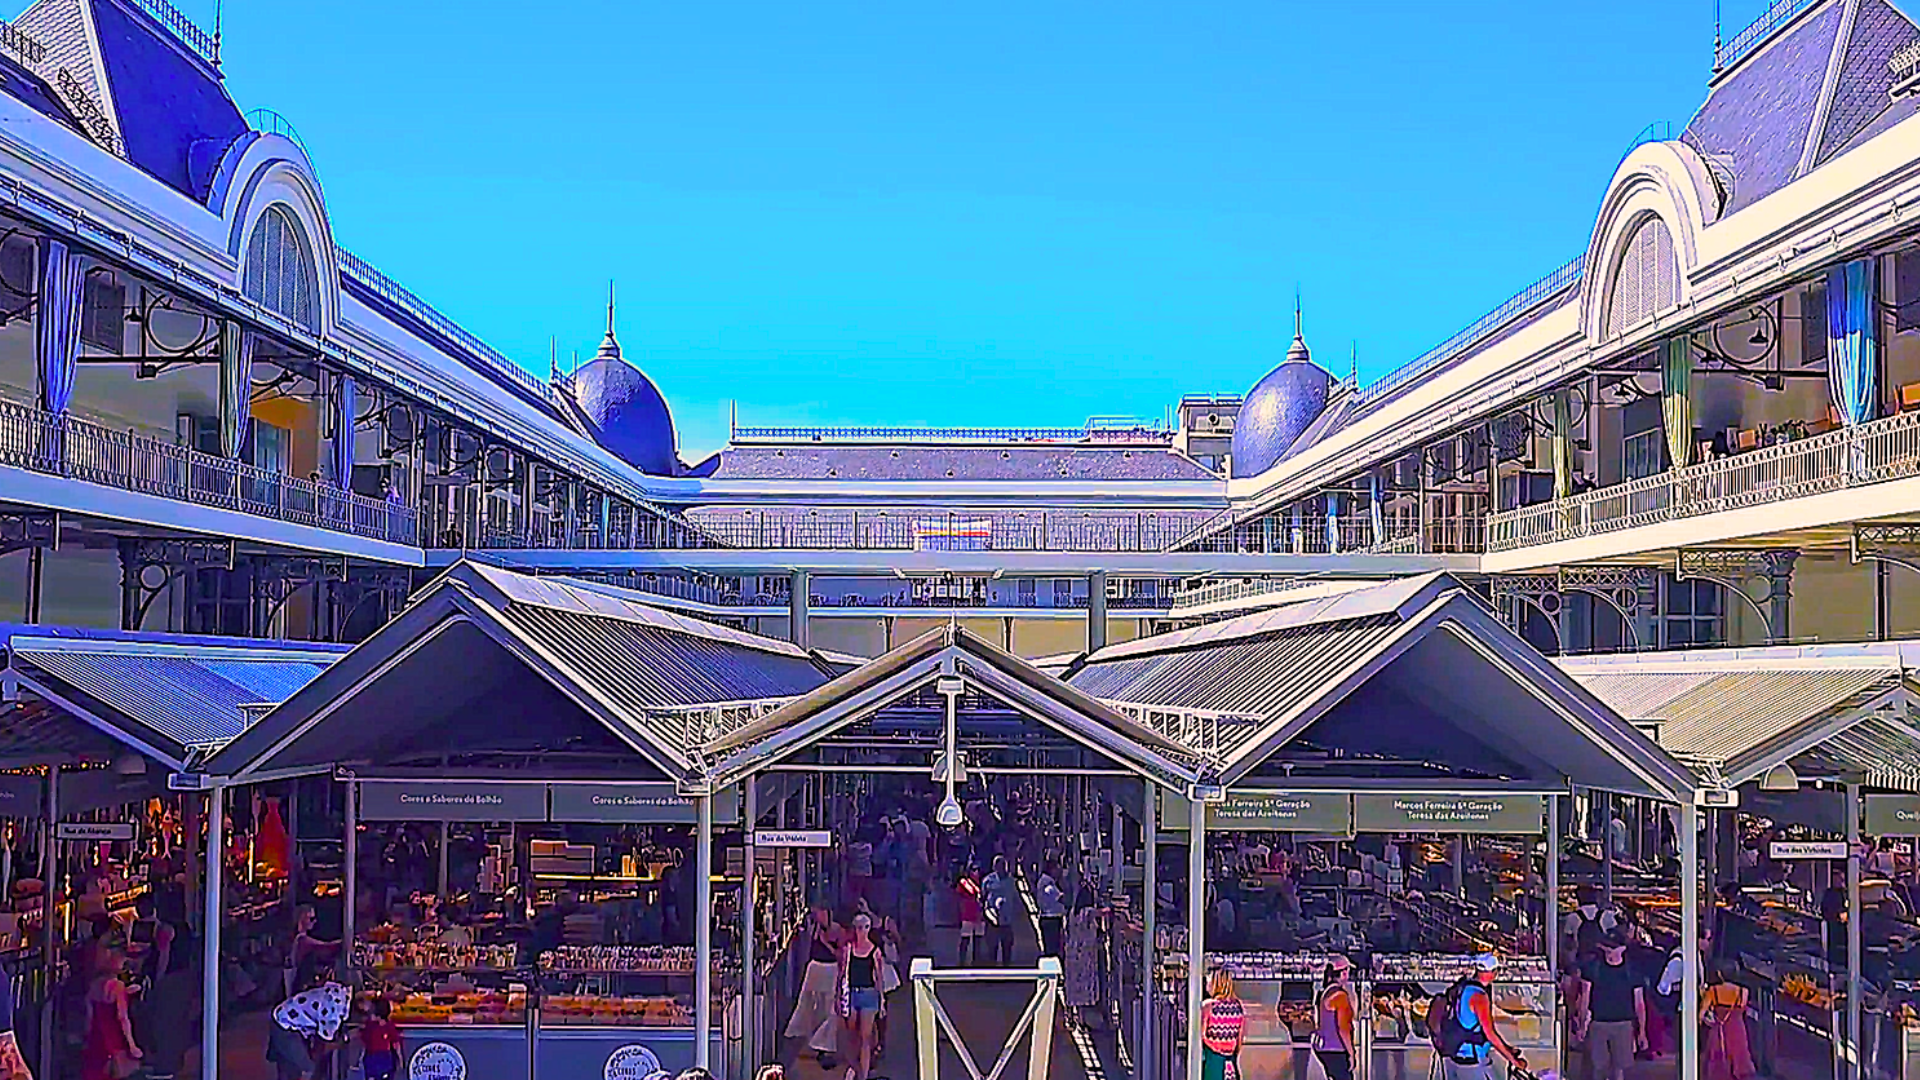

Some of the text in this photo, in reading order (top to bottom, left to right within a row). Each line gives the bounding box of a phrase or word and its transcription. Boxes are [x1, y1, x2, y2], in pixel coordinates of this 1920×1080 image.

[400, 793, 424, 804] Cores
[432, 794, 463, 804] Sabores
[592, 795, 616, 805] Cores
[624, 795, 654, 805] Sabores
[1231, 799, 1263, 808] Ferreira
[1275, 799, 1311, 810] Geração
[1394, 800, 1423, 810] Marcos
[1425, 800, 1456, 810] Ferreira
[1468, 801, 1503, 811] Geração
[1214, 809, 1240, 818] Teresa
[1242, 809, 1256, 818] das
[1407, 811, 1433, 820] Teresa
[1434, 811, 1449, 820] das
